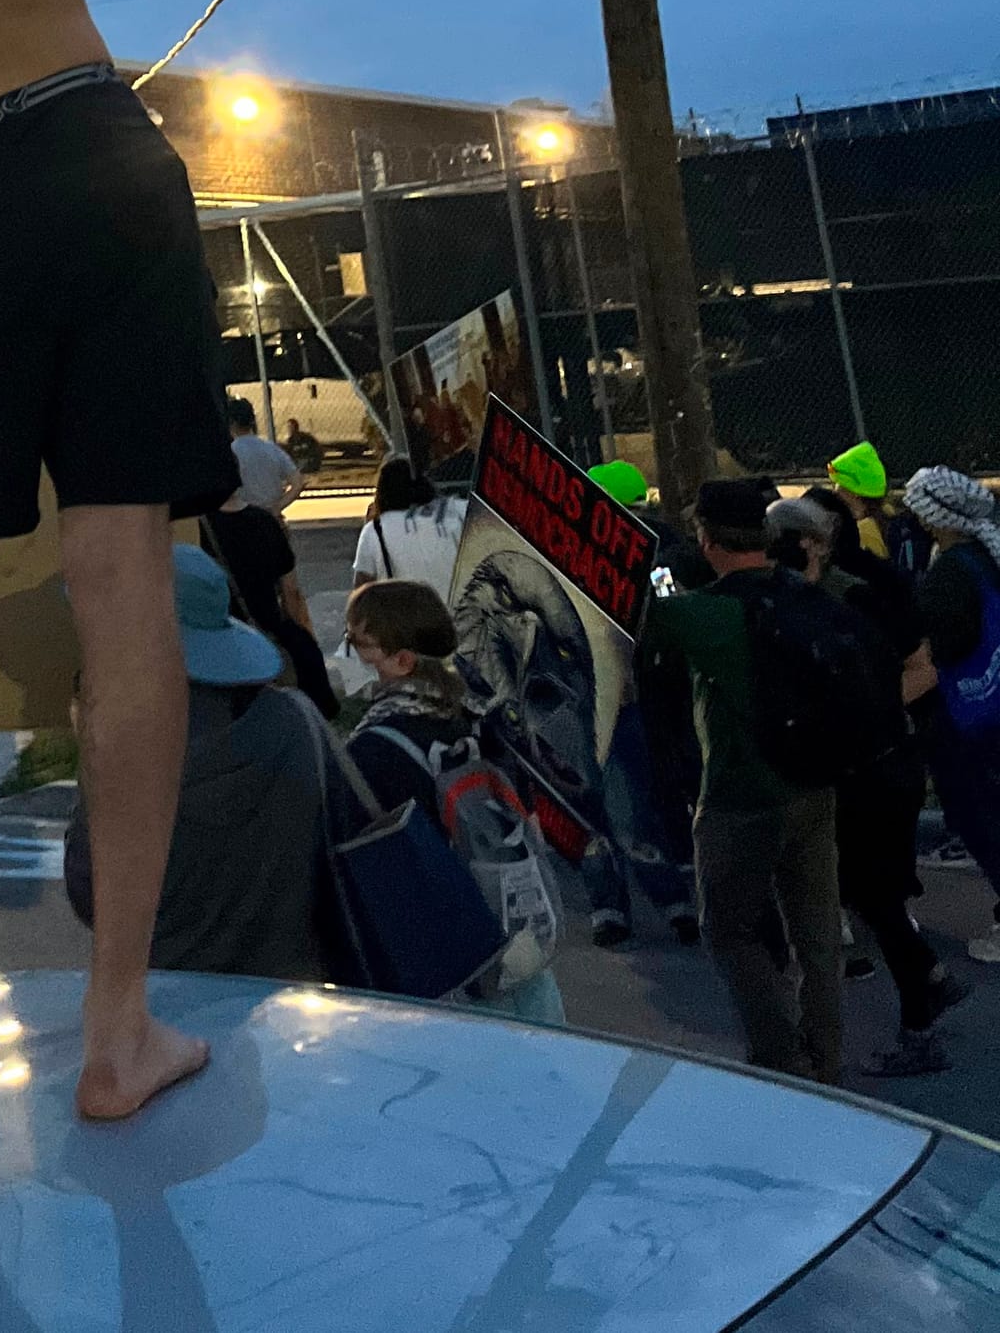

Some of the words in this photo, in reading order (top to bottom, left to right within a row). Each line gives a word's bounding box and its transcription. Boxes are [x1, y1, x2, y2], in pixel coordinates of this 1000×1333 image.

[482, 456, 636, 620] DEMOCRACY!
[492, 413, 585, 521] HANDS
[591, 500, 648, 571] OFF
